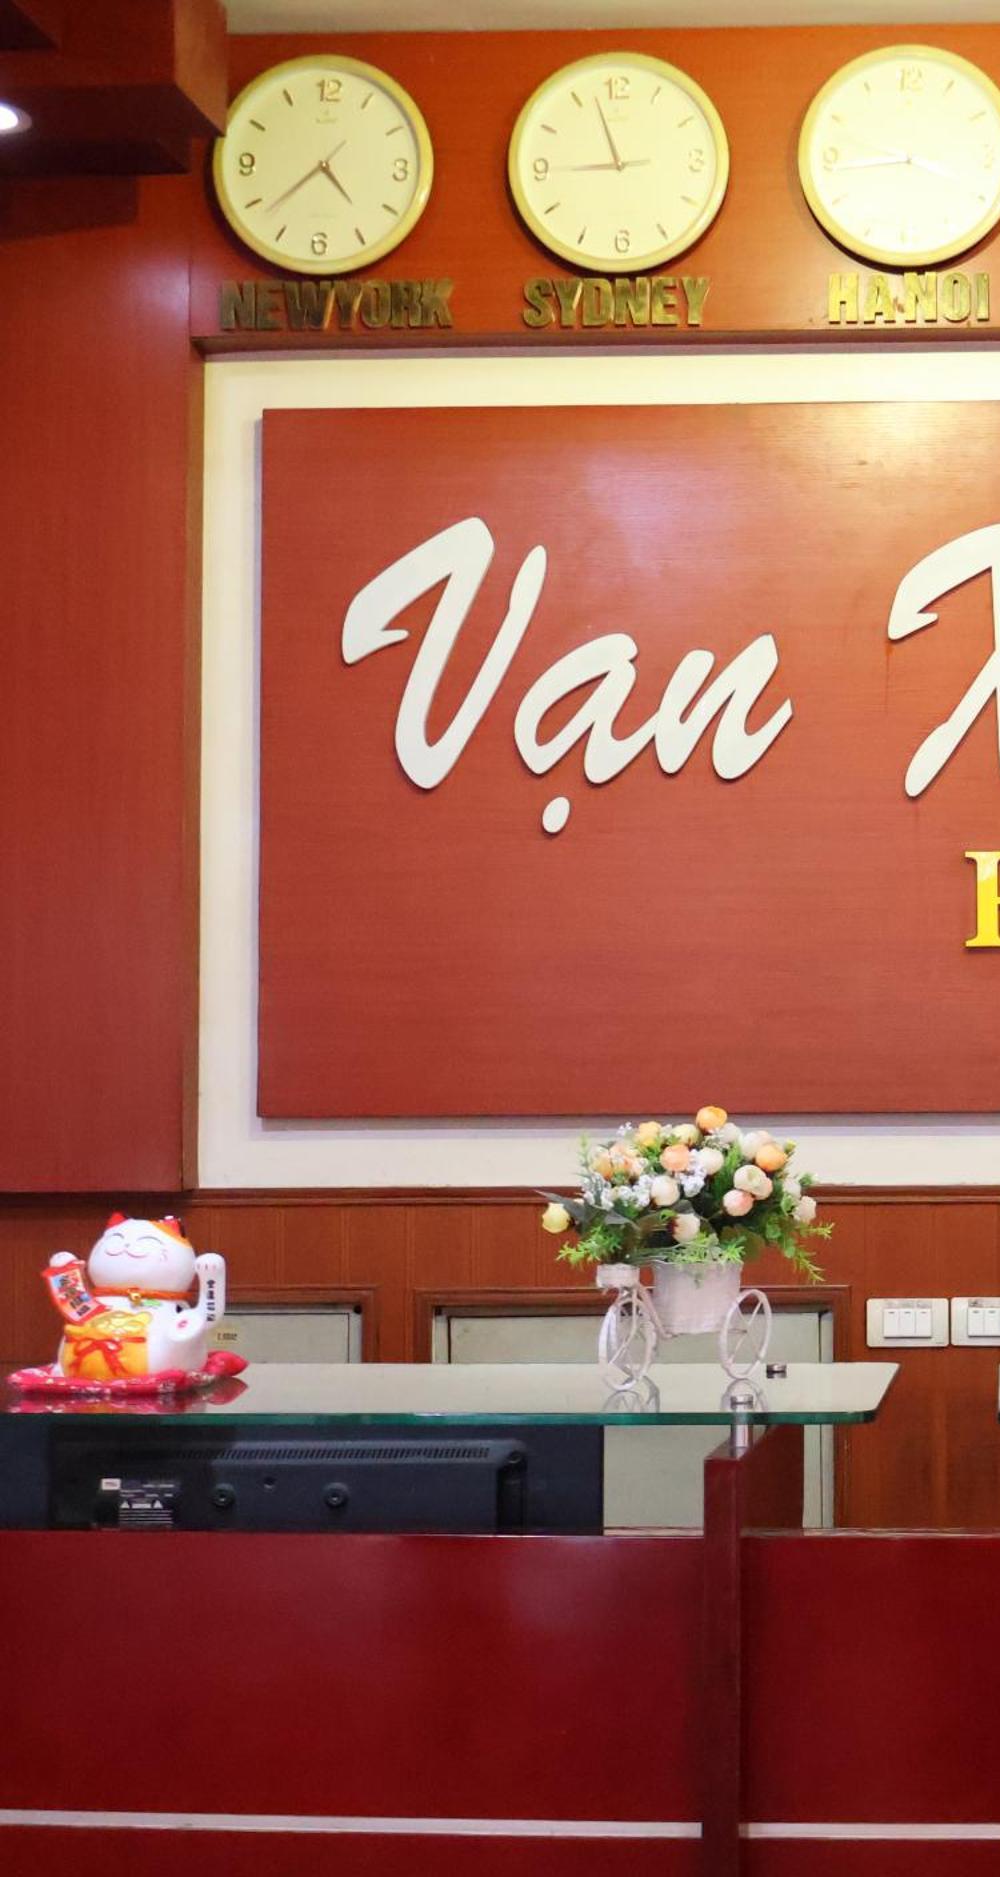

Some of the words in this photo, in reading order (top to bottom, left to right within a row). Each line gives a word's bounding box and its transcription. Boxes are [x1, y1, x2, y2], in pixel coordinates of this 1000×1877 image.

[317, 79, 342, 102] 12
[604, 76, 630, 100] 12
[239, 152, 256, 176] 9
[392, 158, 408, 182] 3
[533, 158, 549, 181] 9
[311, 232, 328, 256] 6
[615, 229, 630, 253] 6
[524, 277, 710, 328] SYDNEY
[828, 271, 990, 325] HANOI
[342, 517, 793, 834] Vạn
